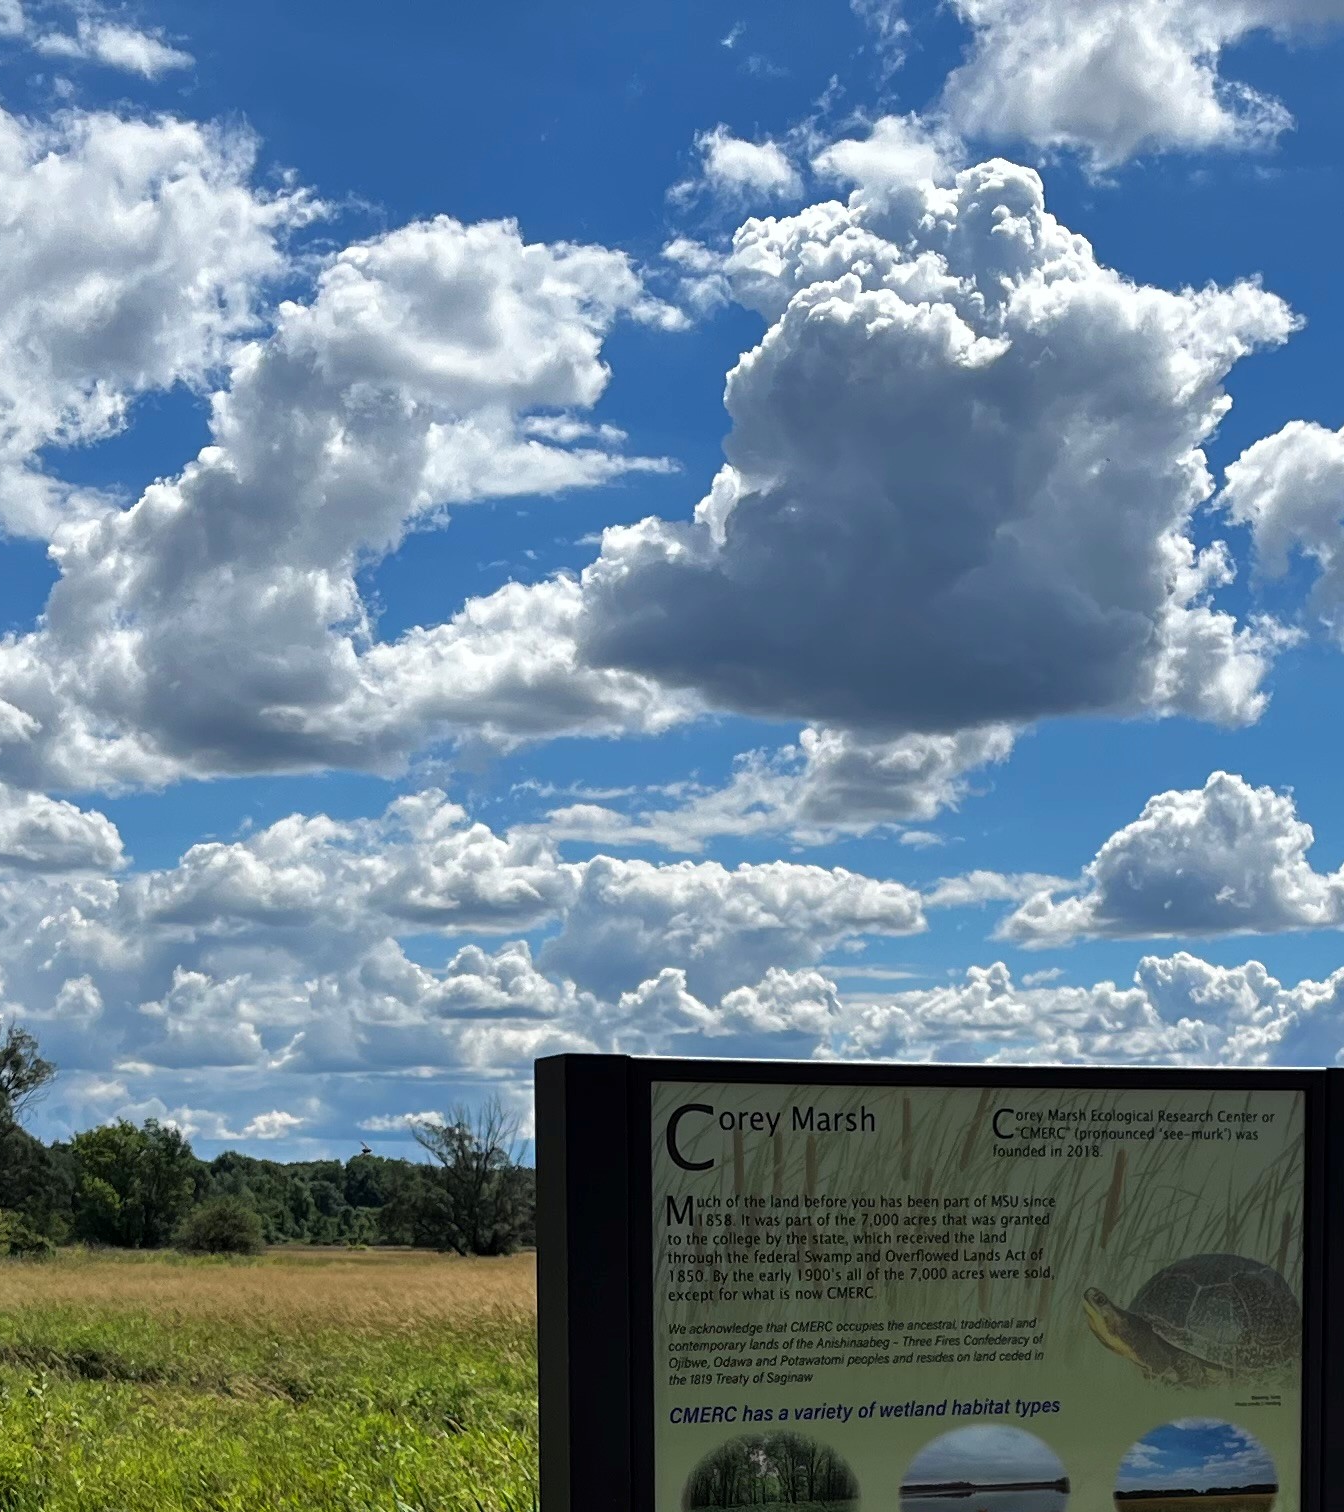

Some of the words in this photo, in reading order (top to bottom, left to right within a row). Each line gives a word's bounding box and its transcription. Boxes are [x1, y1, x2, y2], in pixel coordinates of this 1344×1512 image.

[791, 1105, 875, 1132] Marsh
[1047, 1108, 1087, 1122] Marsh
[1090, 1108, 1154, 1125] Ecological
[1157, 1108, 1213, 1122] Research
[1216, 1108, 1258, 1122] Center
[1260, 1112, 1275, 1123] or
[992, 1143, 1046, 1157] founded
[1049, 1144, 1062, 1158] in
[667, 1286, 714, 1305] except
[718, 1286, 738, 1301] for
[741, 1286, 775, 1301] what
[778, 1286, 790, 1300] is
[794, 1289, 823, 1300] now
[826, 1284, 877, 1300] CMERC.
[668, 1372, 687, 1386] the
[689, 1371, 713, 1385] 1819
[716, 1370, 750, 1388] Treaty
[751, 1370, 764, 1384] of
[766, 1370, 814, 1387] Saginaw
[669, 1404, 737, 1422] CMERC
[741, 1404, 773, 1421] has
[777, 1407, 789, 1420] a
[793, 1402, 853, 1423] variety
[857, 1401, 874, 1418] of
[879, 1400, 946, 1418] wetland
[951, 1398, 1010, 1417] habitat
[1014, 1398, 1060, 1419] types
